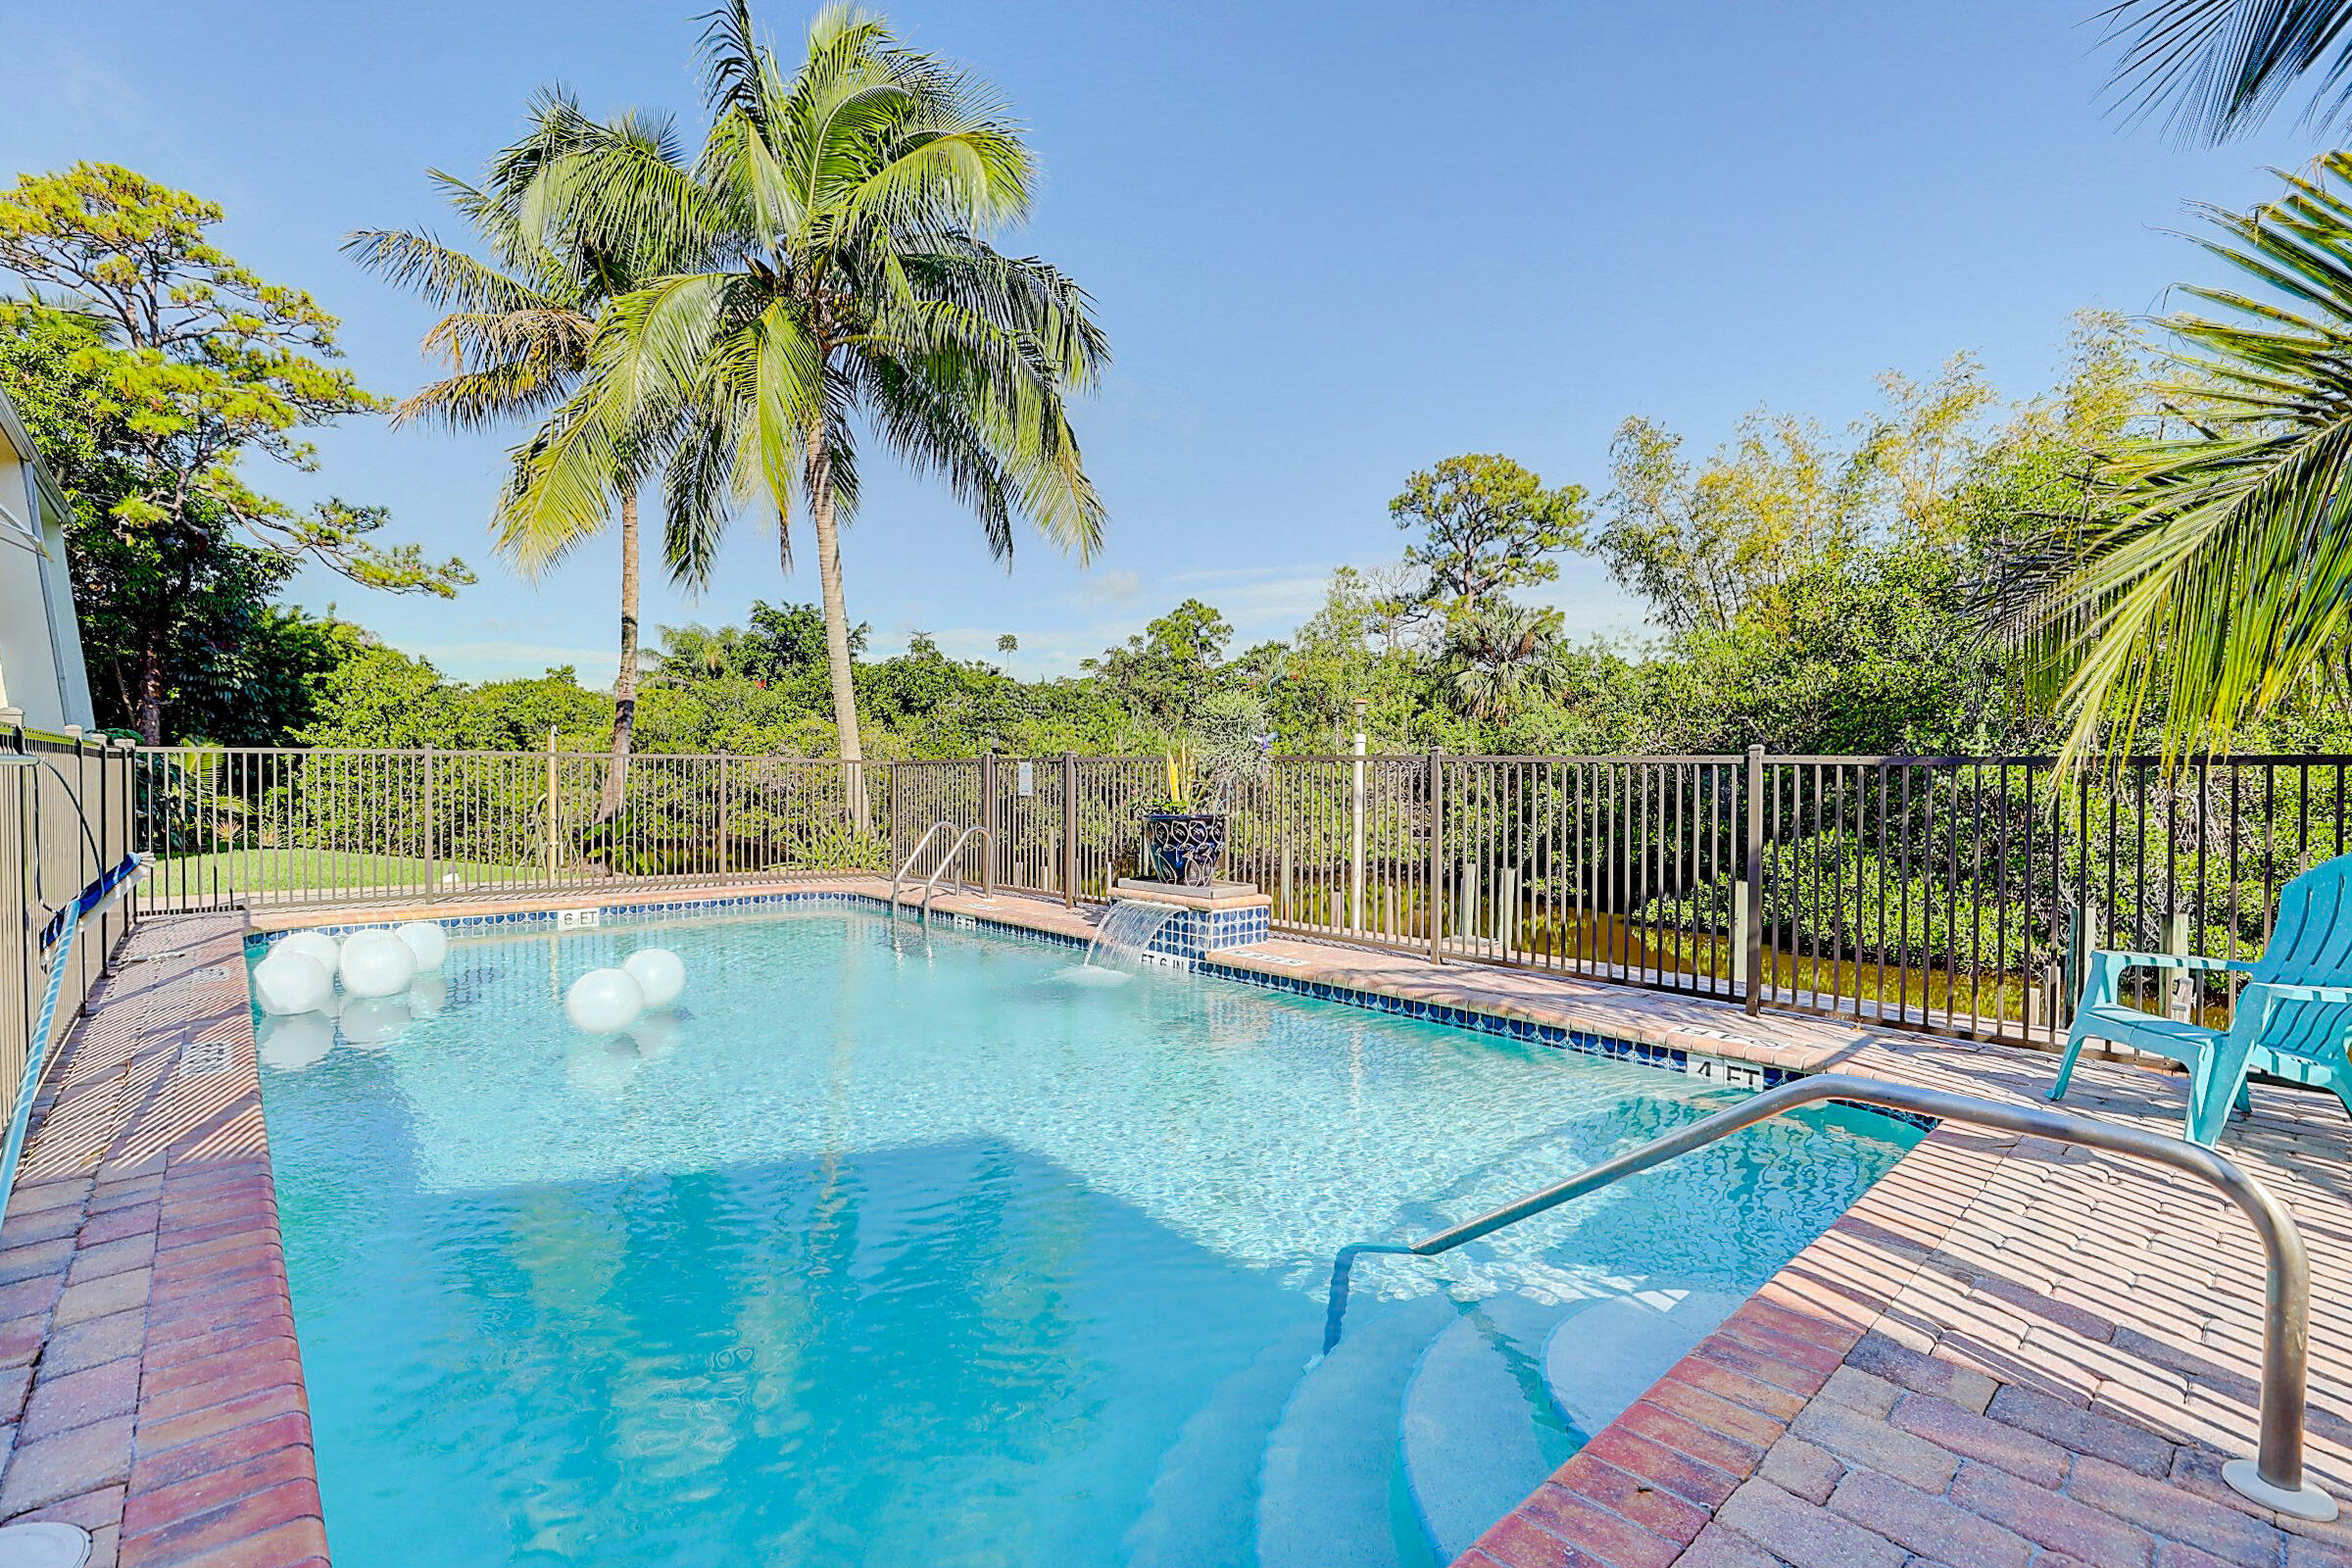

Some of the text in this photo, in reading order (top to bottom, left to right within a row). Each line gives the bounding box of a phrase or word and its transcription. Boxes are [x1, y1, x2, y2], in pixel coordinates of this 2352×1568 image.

[1141, 954, 1154, 965] FT
[1172, 959, 1184, 970] IN
[1696, 1060, 1760, 1086] 4 FT
